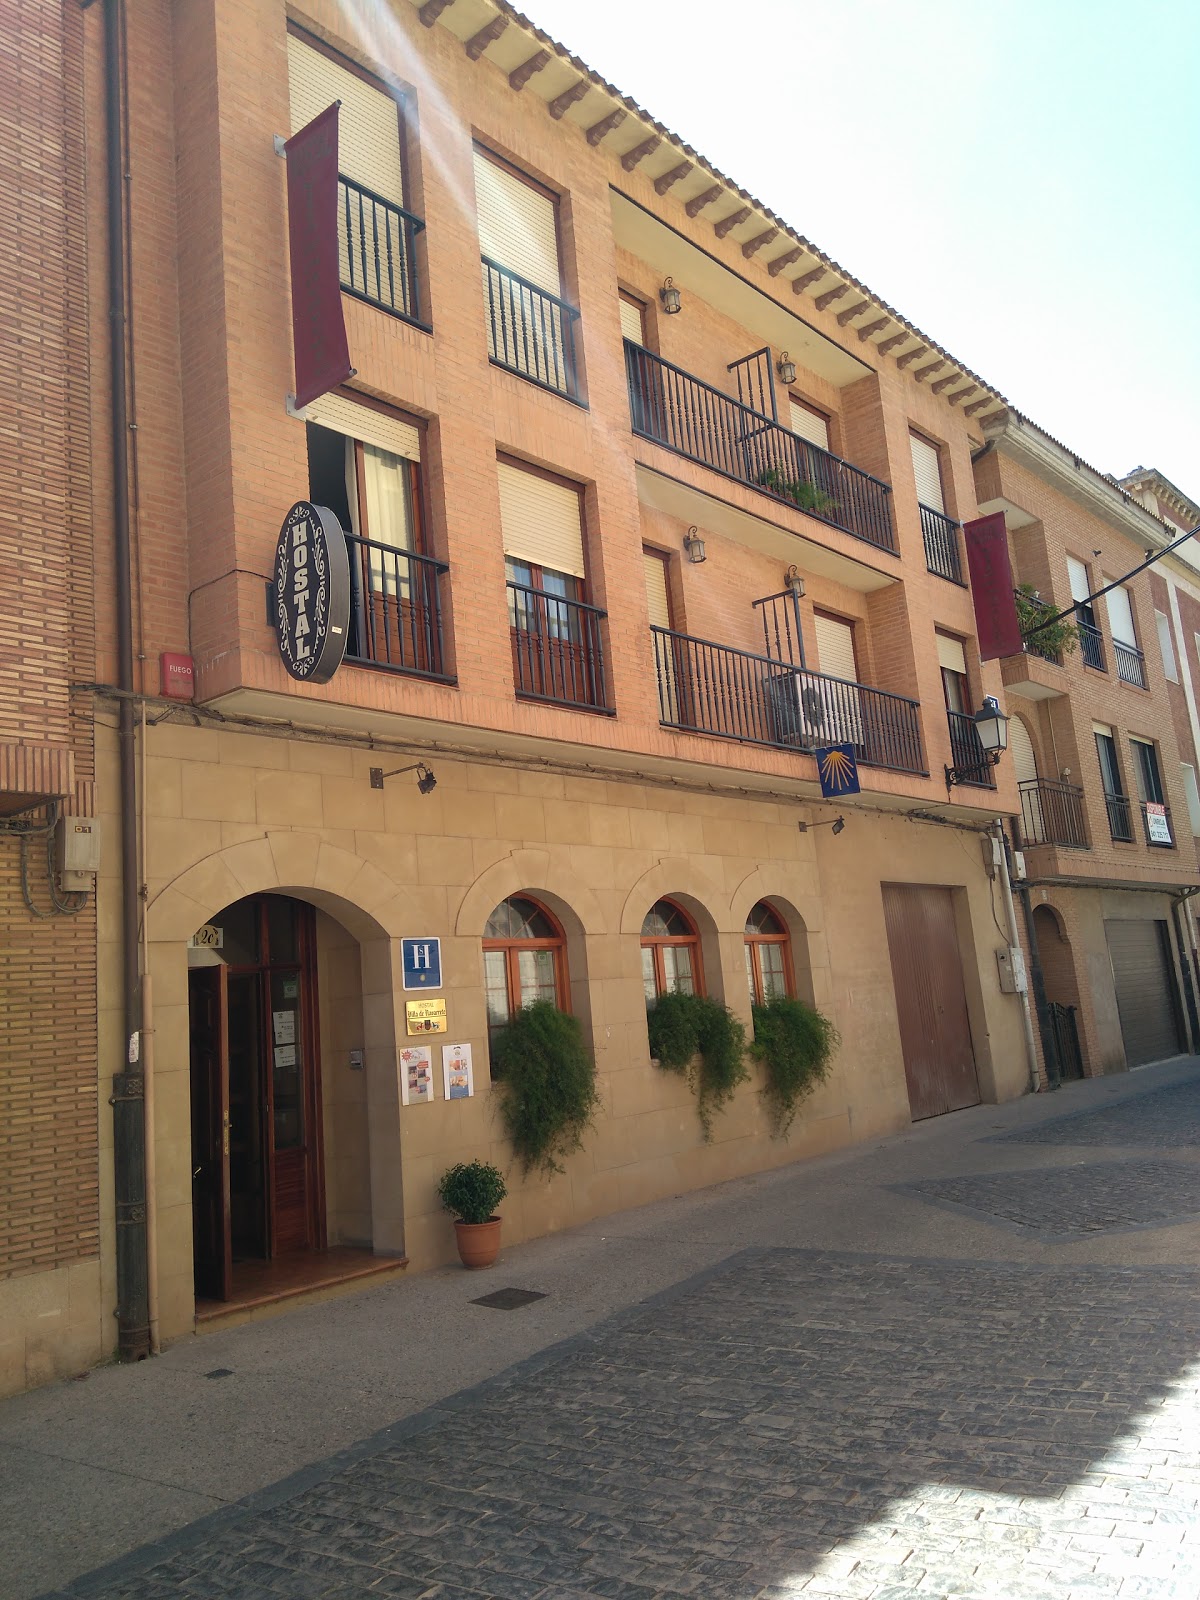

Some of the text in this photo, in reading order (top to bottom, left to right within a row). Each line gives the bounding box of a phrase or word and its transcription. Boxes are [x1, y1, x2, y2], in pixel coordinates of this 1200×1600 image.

[292, 521, 311, 661] HOSTAL
[169, 664, 192, 675] FUEGO
[1147, 802, 1165, 815] DISPONIBLE
